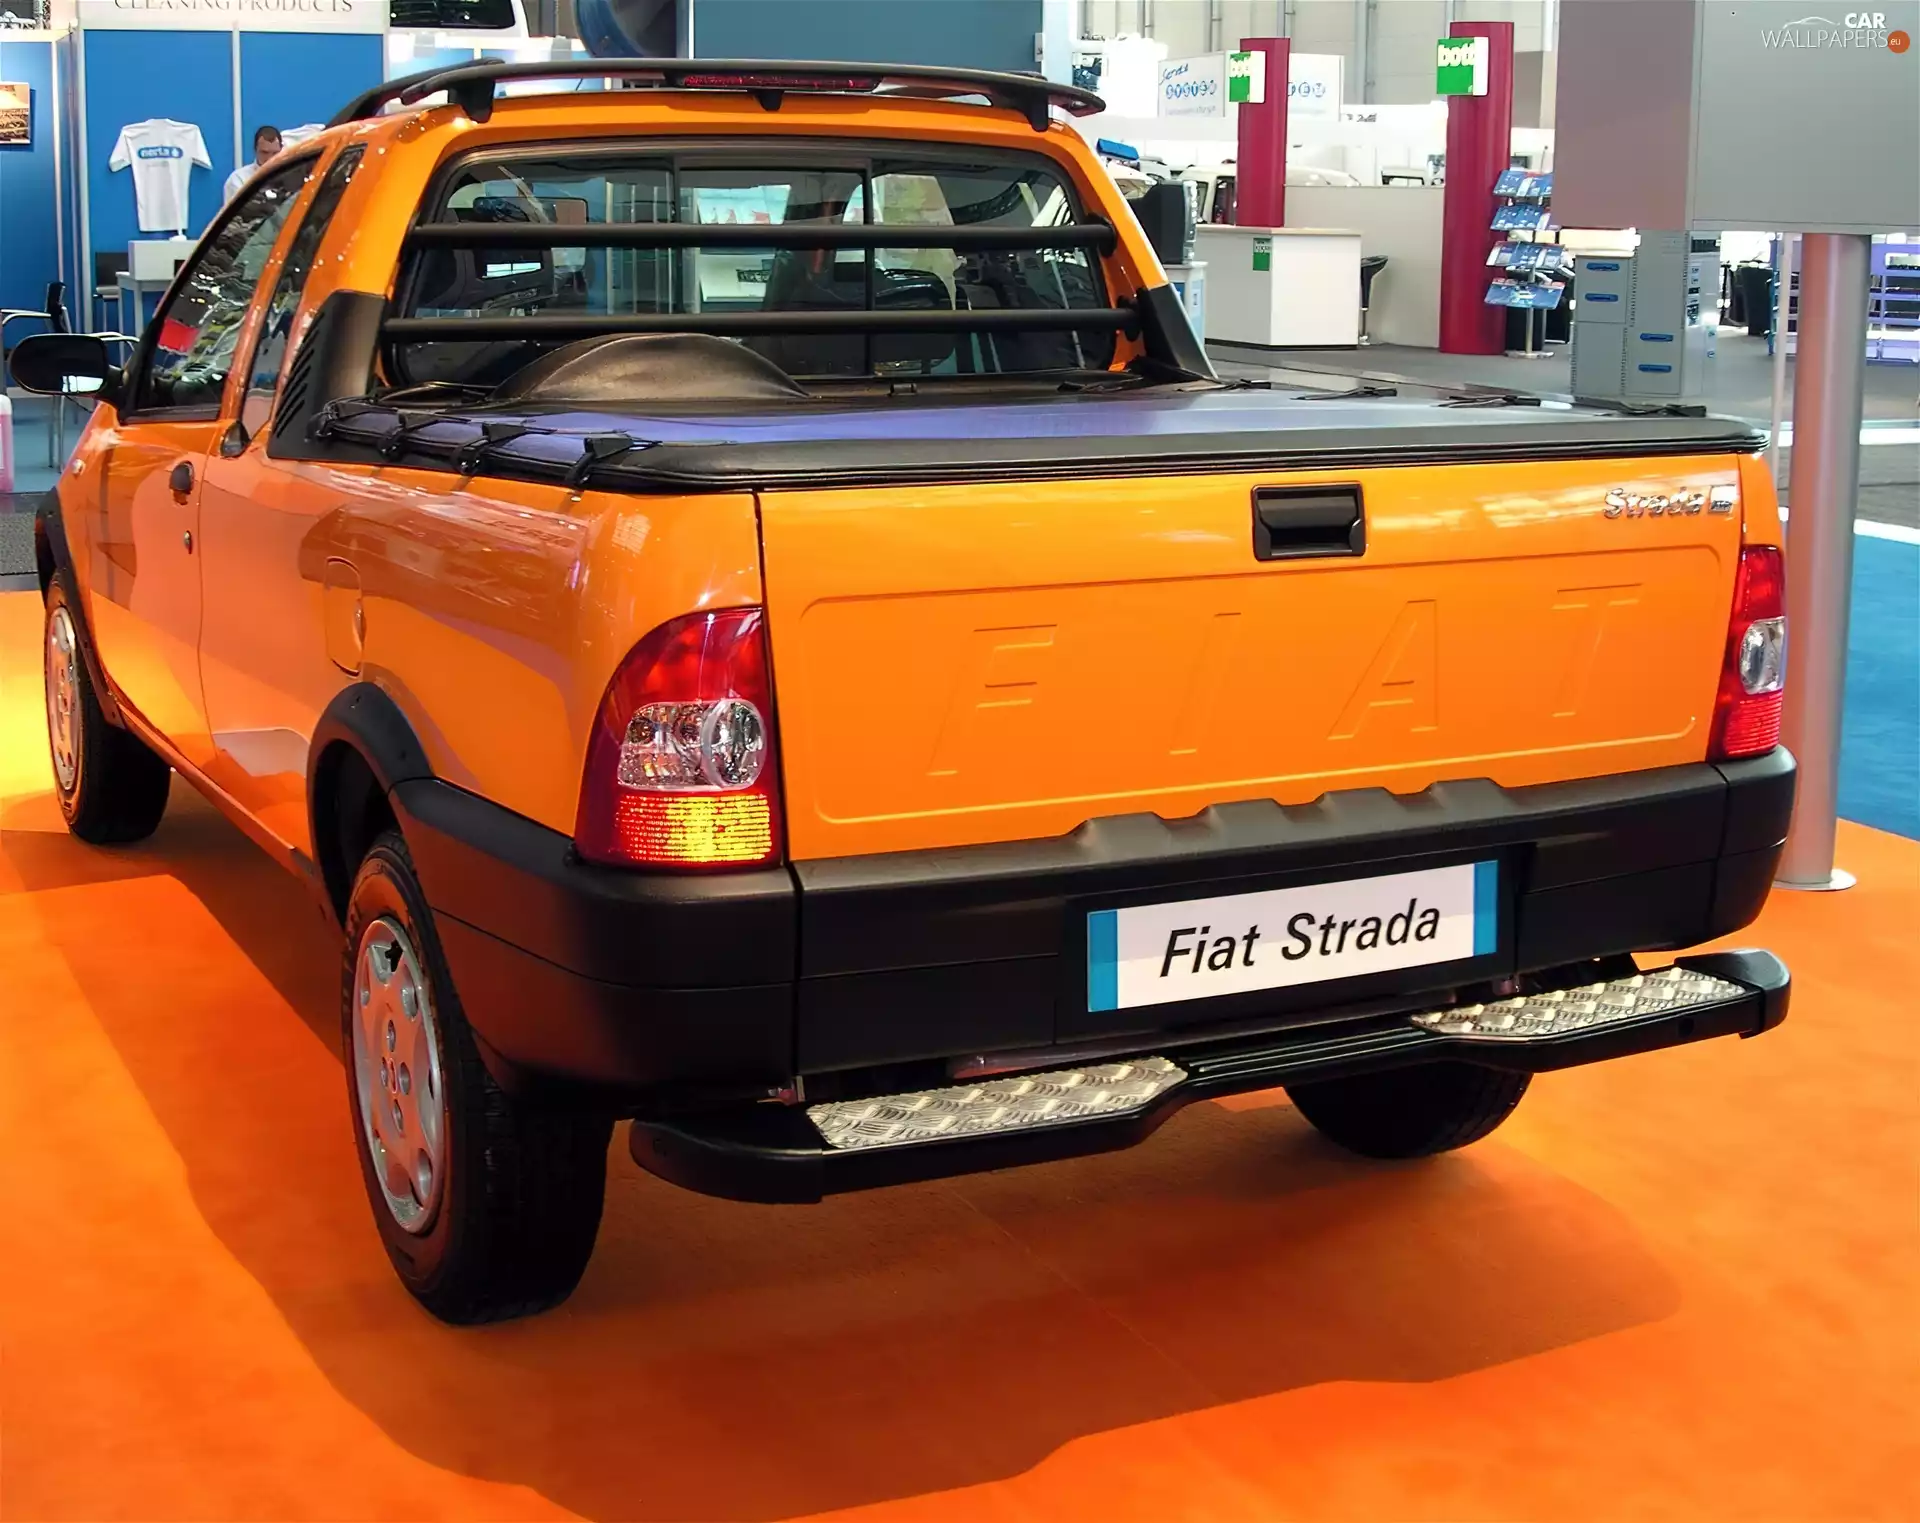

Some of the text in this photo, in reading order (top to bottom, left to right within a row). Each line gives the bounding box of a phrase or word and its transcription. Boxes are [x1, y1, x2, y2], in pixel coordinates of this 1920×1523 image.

[1603, 486, 1706, 520] Strada
[926, 583, 1642, 776] FIAT
[1159, 897, 1441, 978] Fiat Strada
